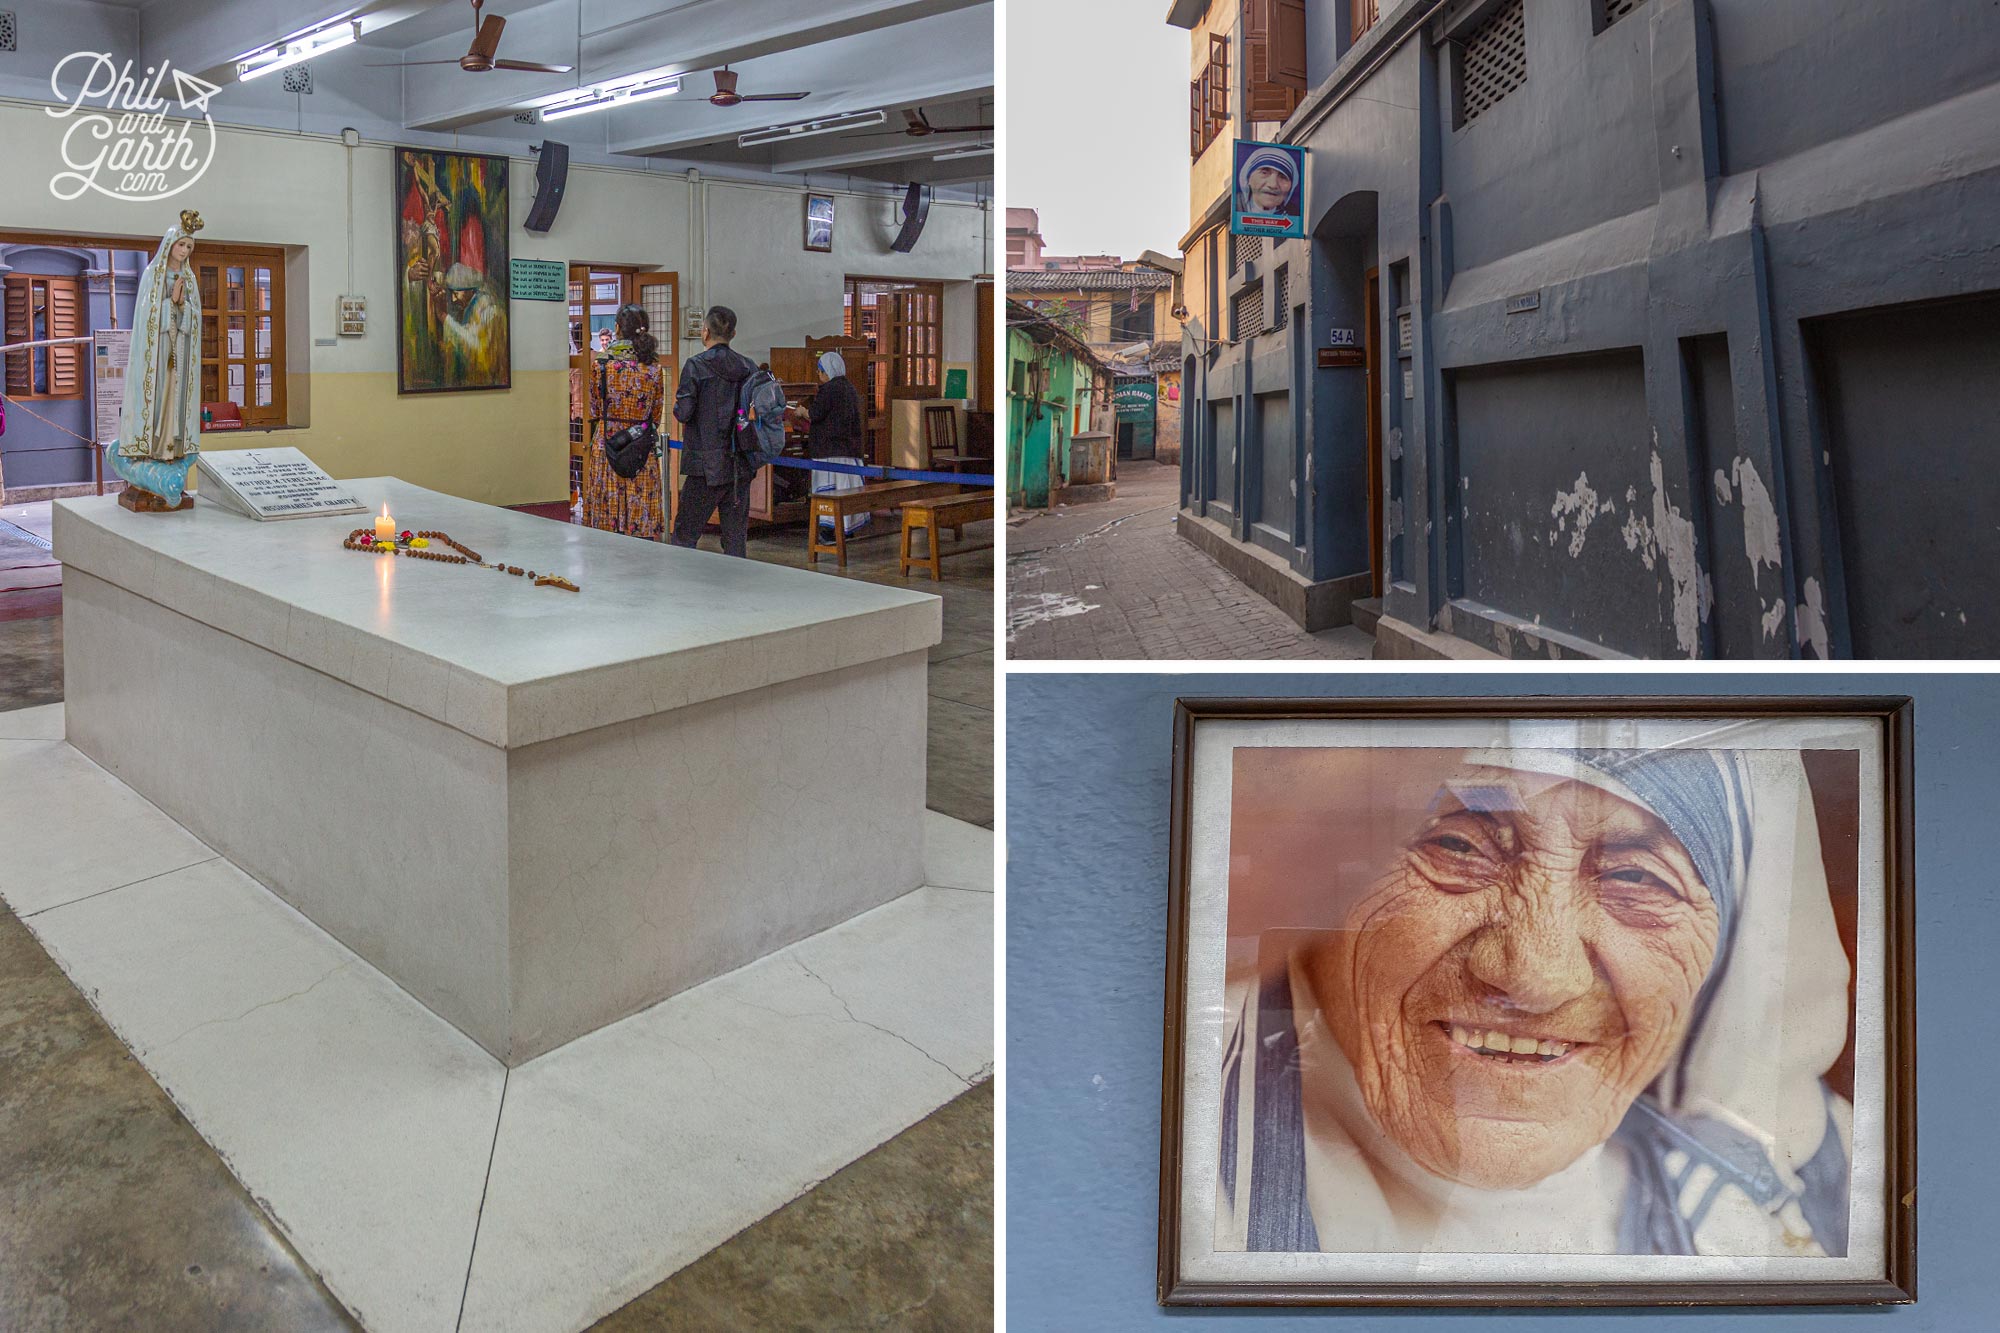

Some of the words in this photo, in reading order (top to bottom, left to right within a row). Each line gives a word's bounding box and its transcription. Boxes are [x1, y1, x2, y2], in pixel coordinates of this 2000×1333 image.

[1332, 330, 1343, 343] 54
[1345, 330, 1354, 343] A
[261, 502, 313, 511] MISSIONARIES
[323, 497, 356, 506] CHARITY
